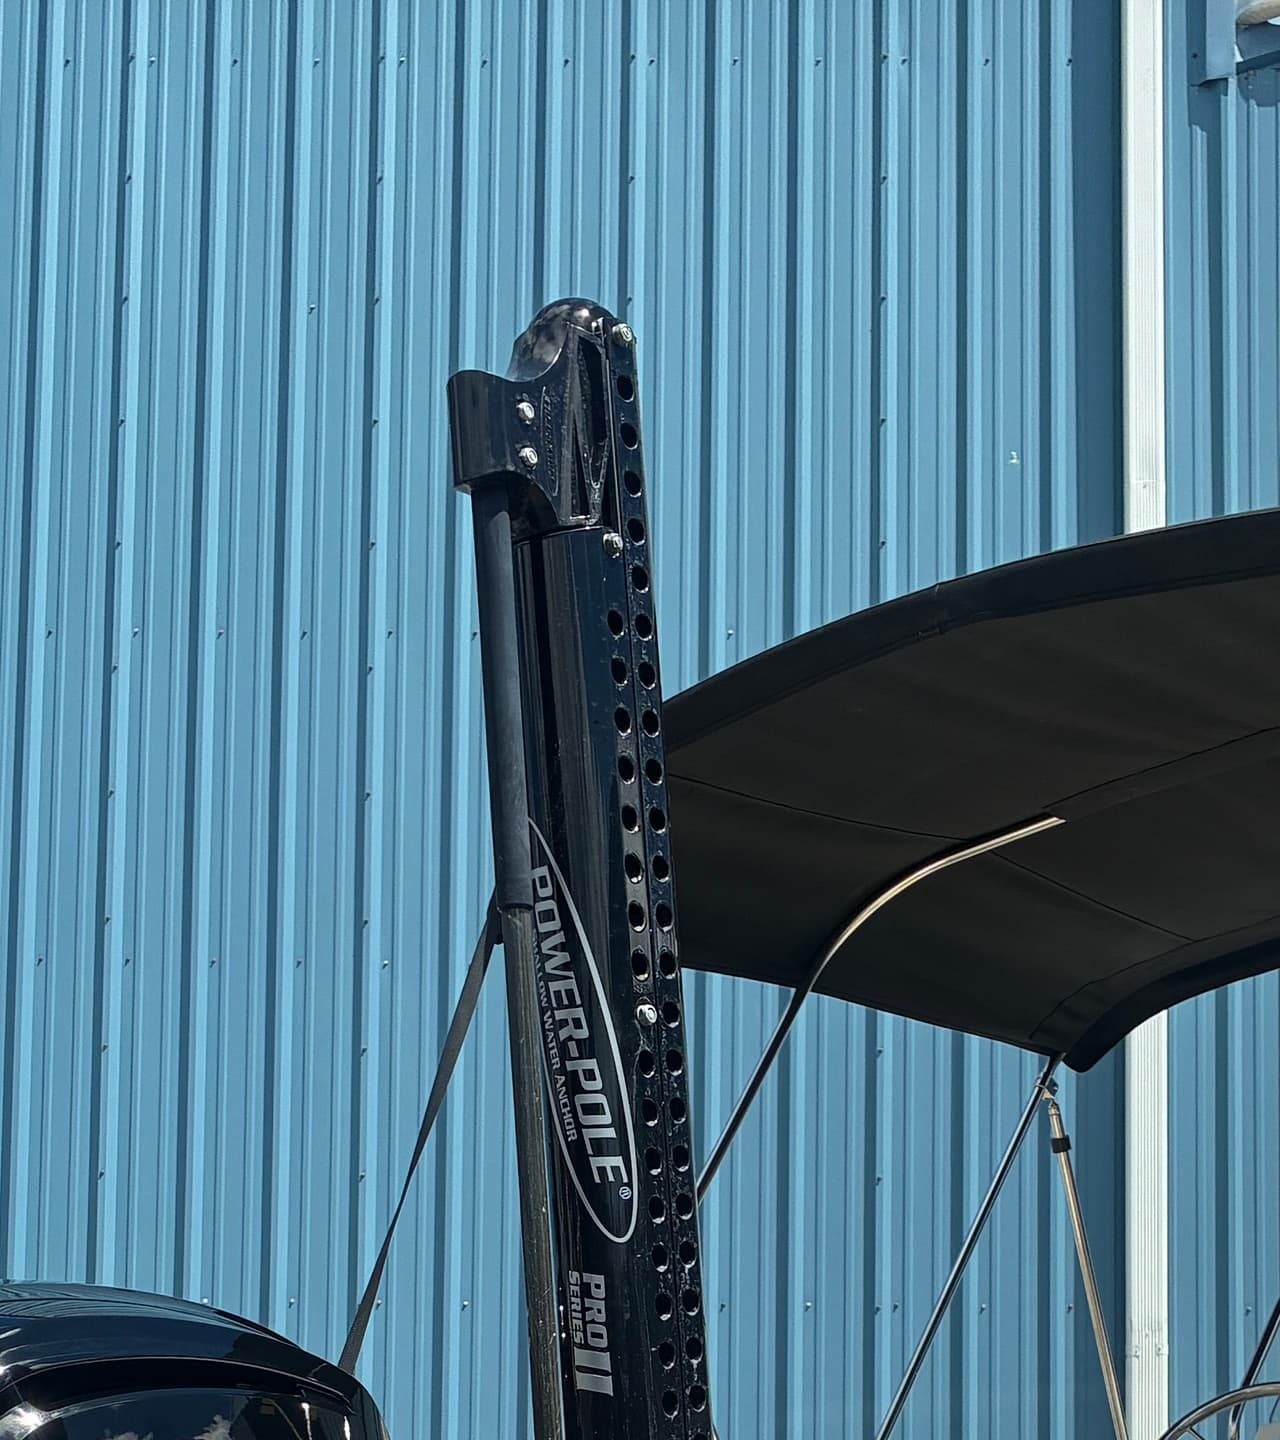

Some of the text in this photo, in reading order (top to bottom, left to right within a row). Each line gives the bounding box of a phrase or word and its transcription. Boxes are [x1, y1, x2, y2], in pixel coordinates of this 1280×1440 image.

[543, 1011, 562, 1071] WATER
[555, 1074, 578, 1142] ANCHOR
[568, 1270, 585, 1345] SERIES
[582, 1272, 609, 1349] PRO
